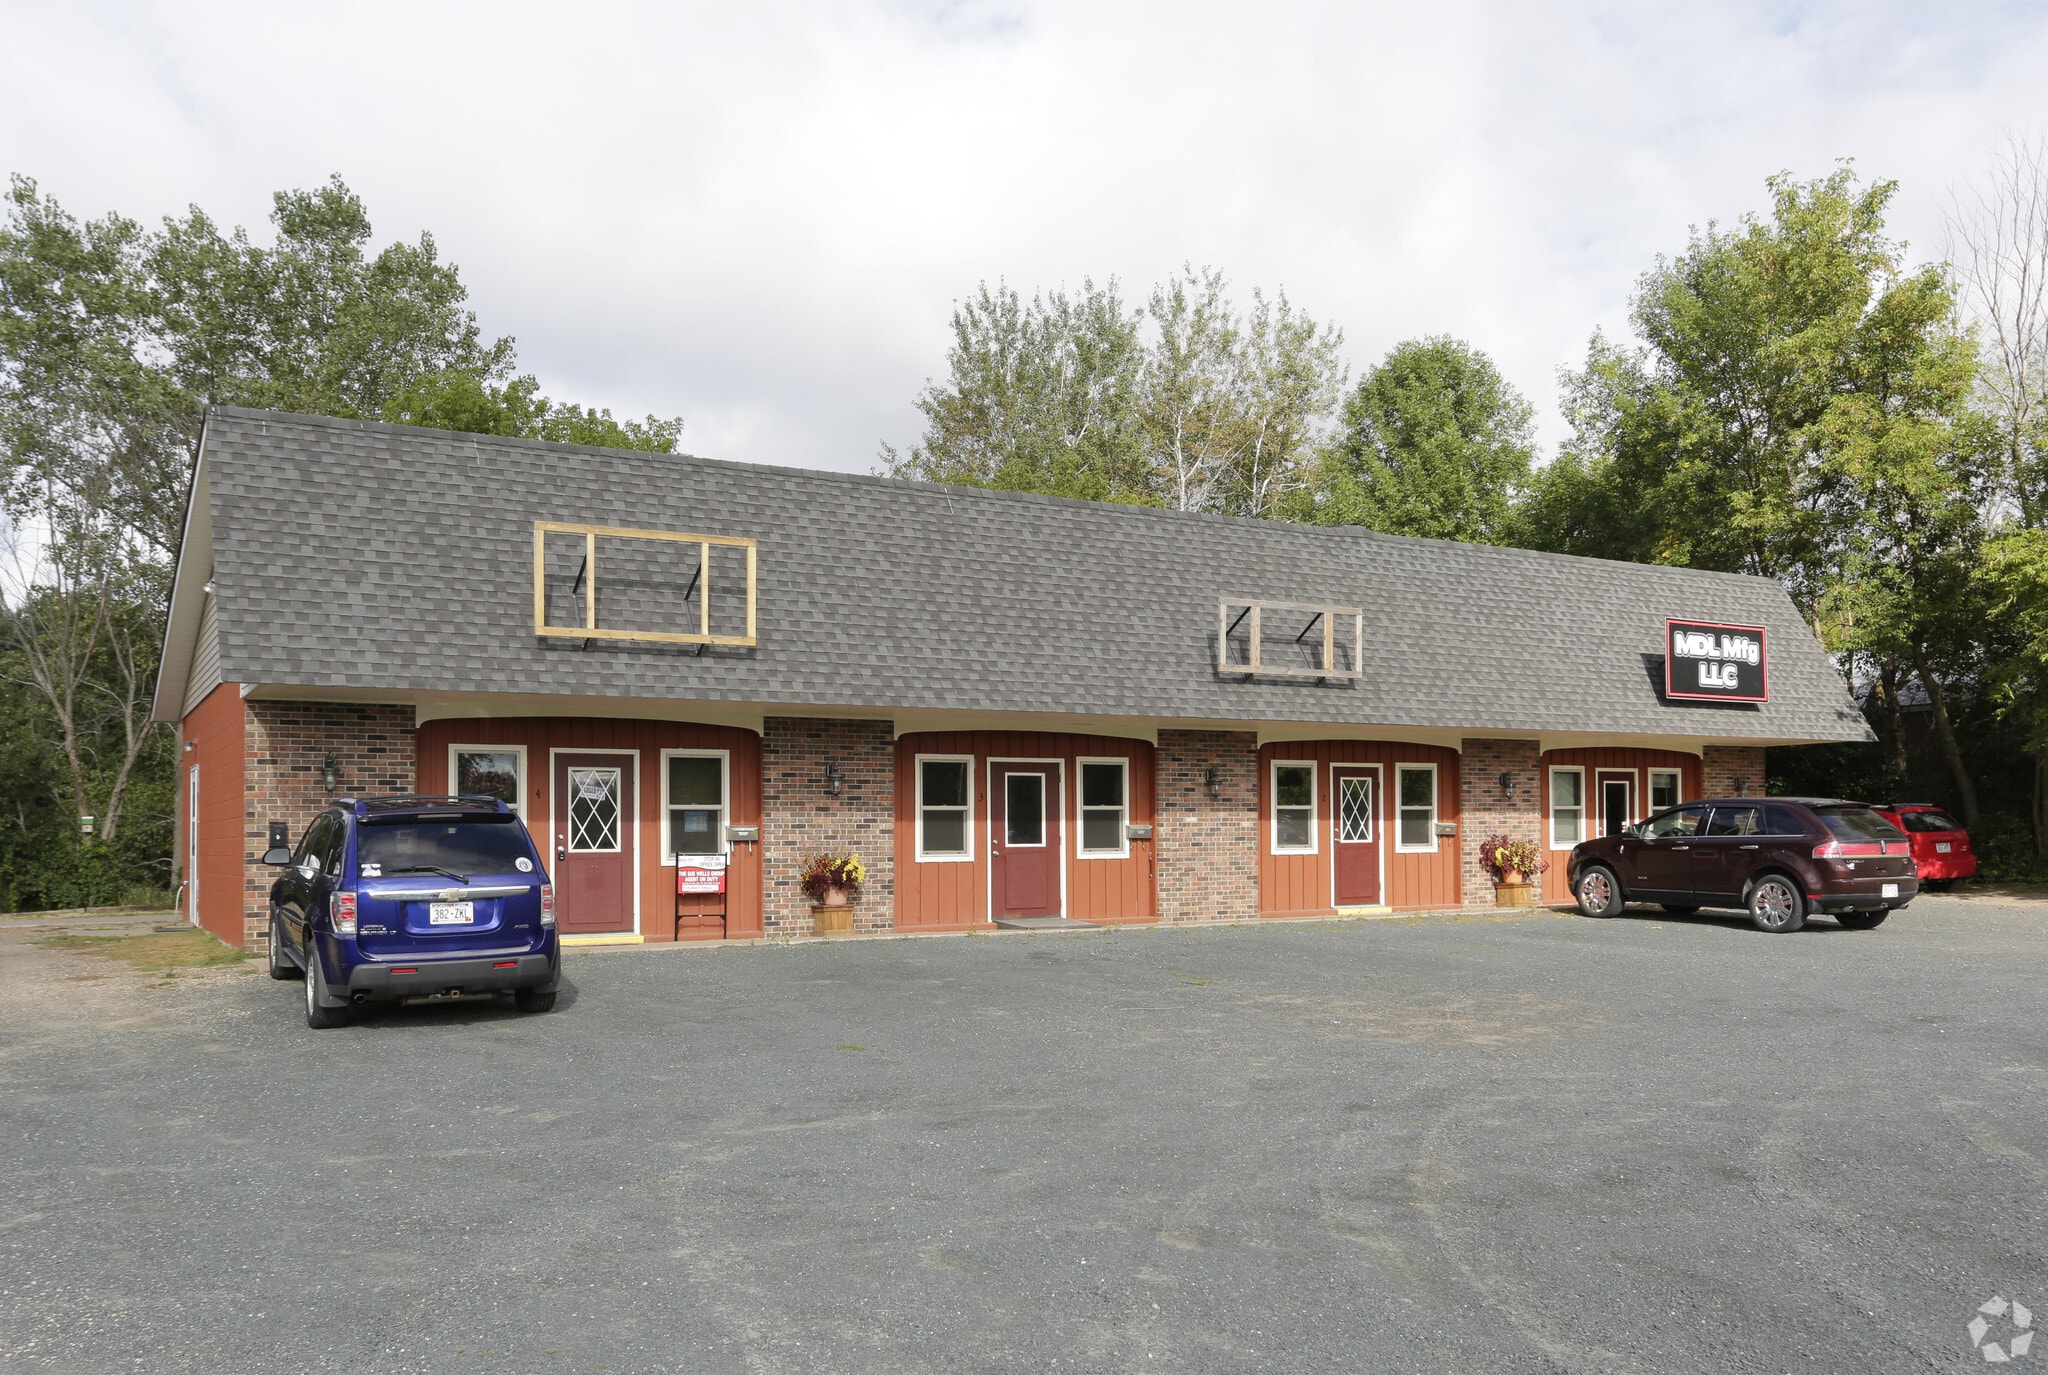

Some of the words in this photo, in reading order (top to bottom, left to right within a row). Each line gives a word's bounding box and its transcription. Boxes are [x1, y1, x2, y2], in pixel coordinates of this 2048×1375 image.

[1674, 631, 1721, 659] MDL
[1721, 635, 1759, 665] Mfg
[1699, 661, 1738, 689] LLC
[535, 789, 541, 799] 4
[979, 793, 984, 801] 3
[1322, 794, 1327, 802] 2
[434, 908, 467, 920] 382-ZKL
